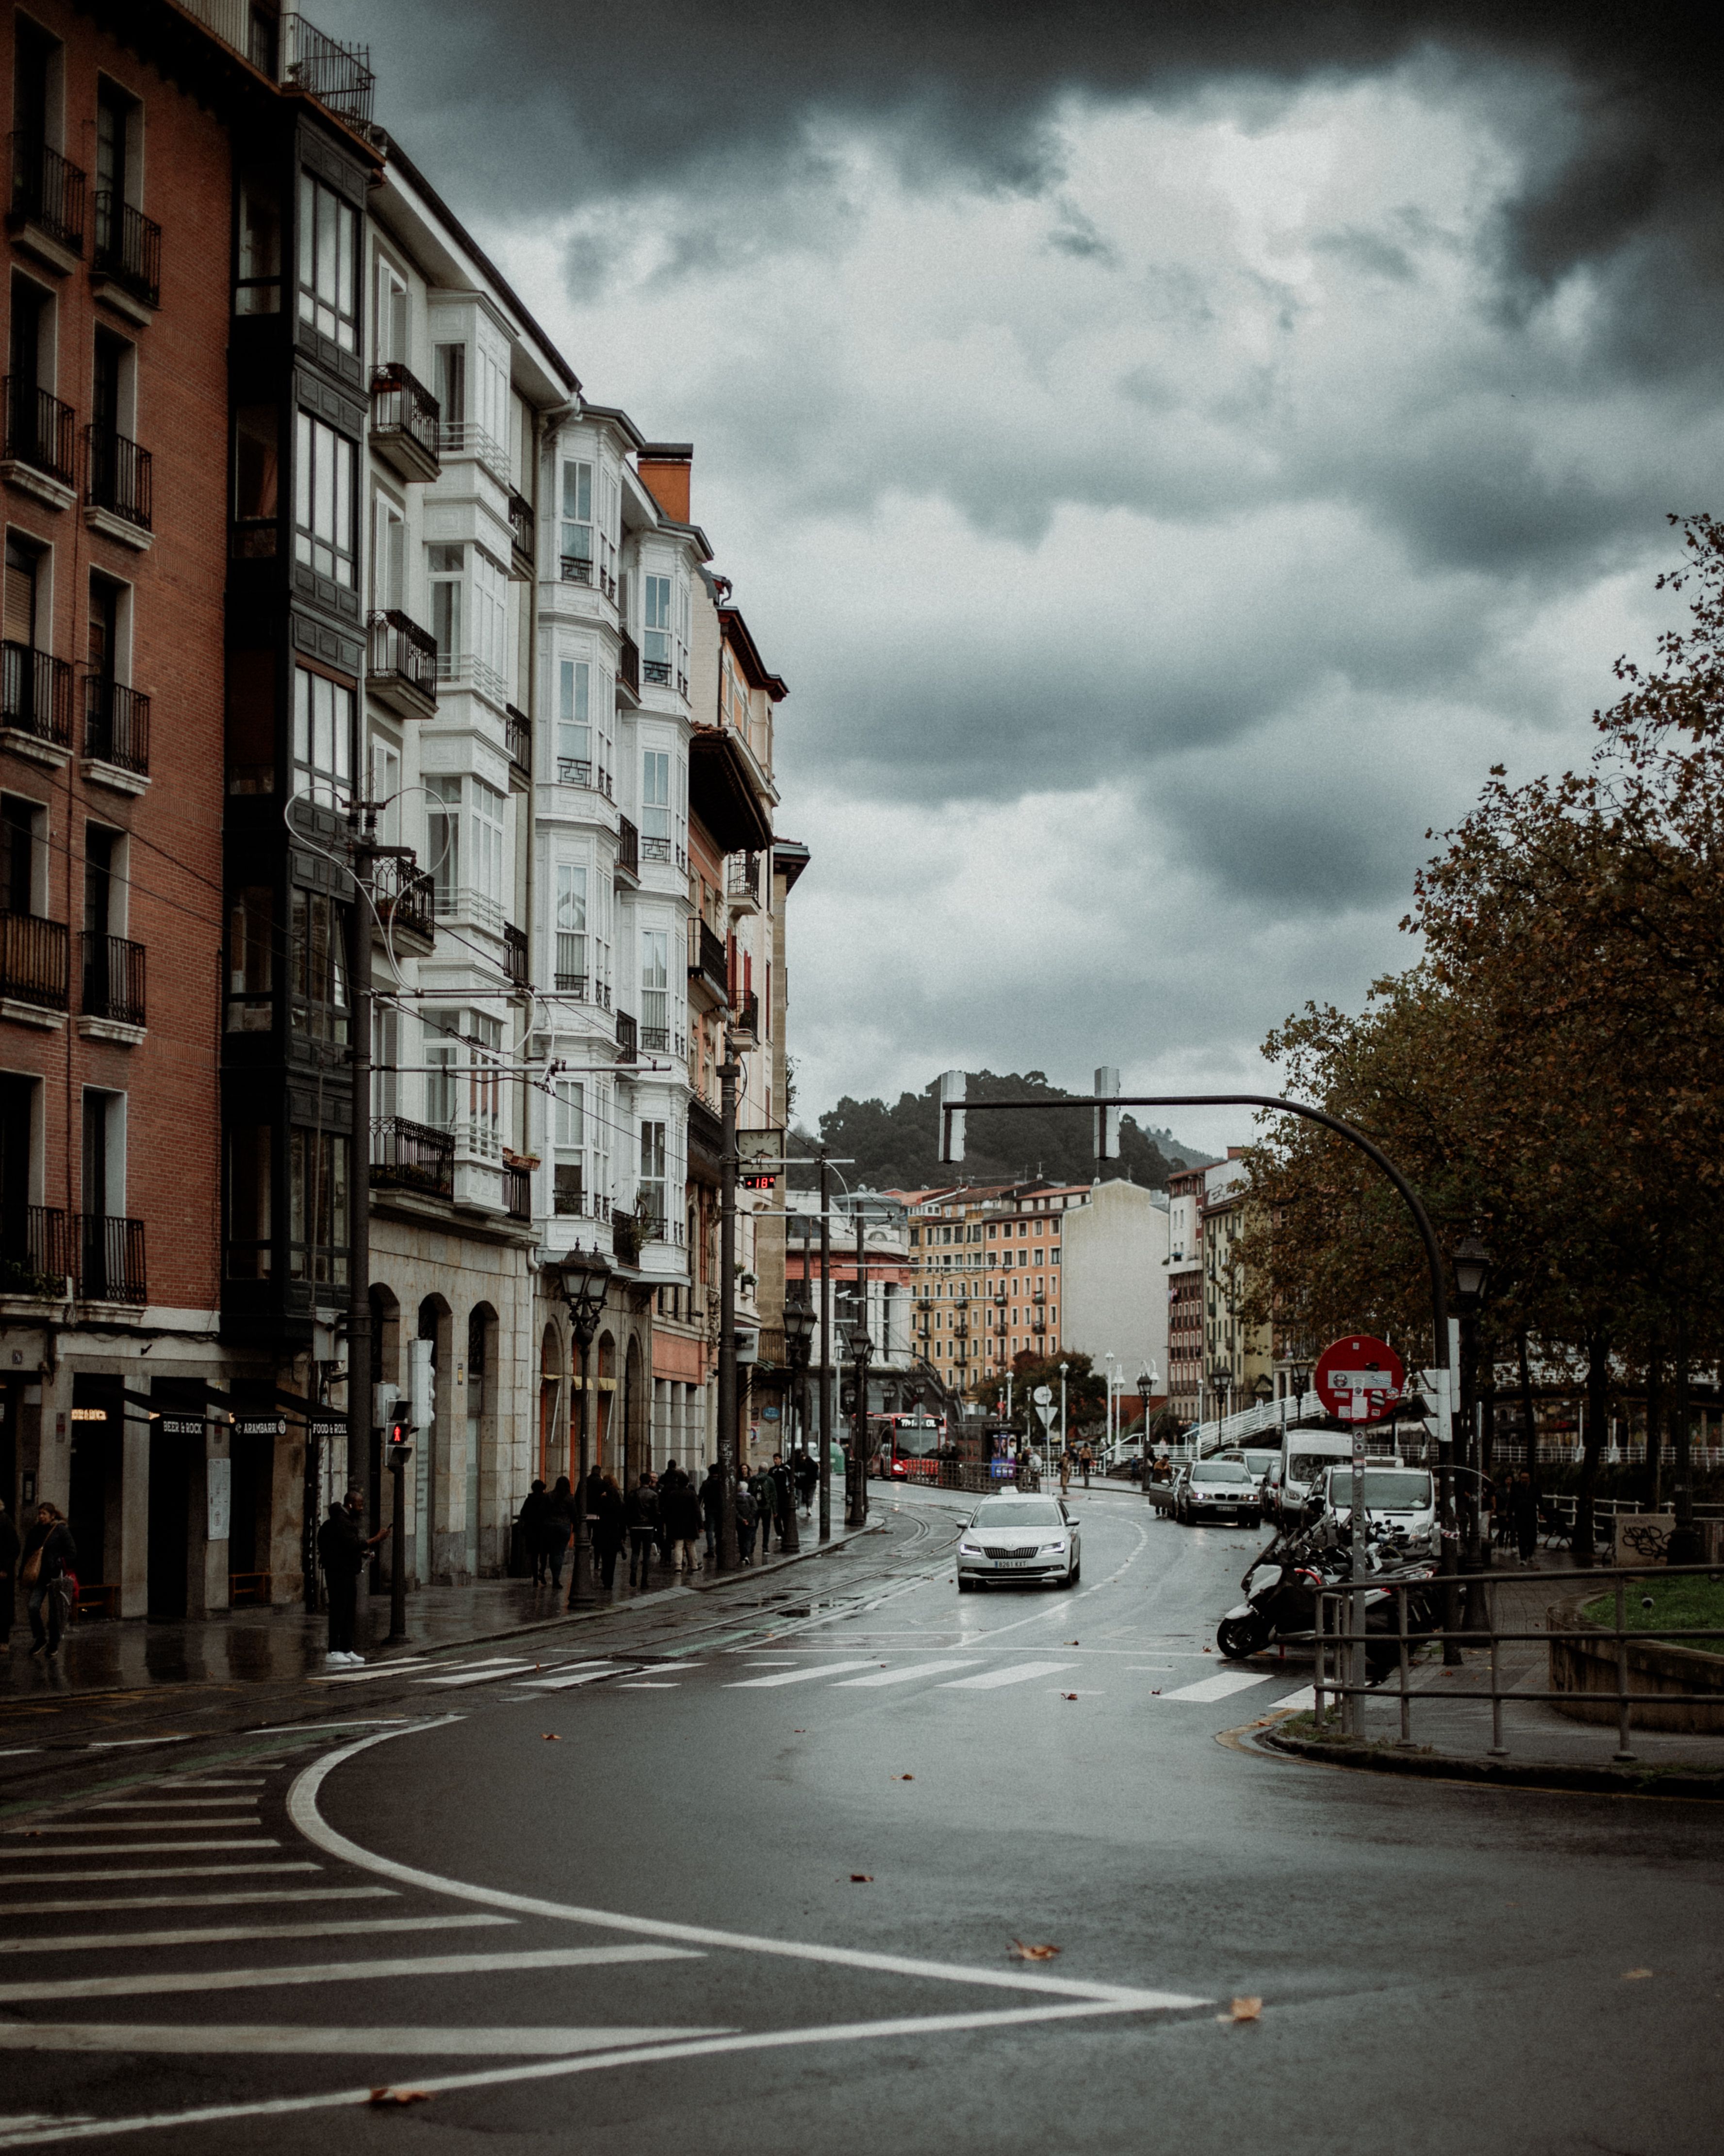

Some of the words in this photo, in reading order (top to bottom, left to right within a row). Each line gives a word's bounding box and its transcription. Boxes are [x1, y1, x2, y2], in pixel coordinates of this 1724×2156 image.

[163, 1421, 180, 1433] BEER
[181, 1421, 185, 1433] &
[186, 1422, 202, 1434] ROCK
[244, 1422, 277, 1434] ARAMBARRI
[312, 1423, 329, 1434] FOOD
[329, 1423, 333, 1434] &
[334, 1423, 347, 1434] ROLL
